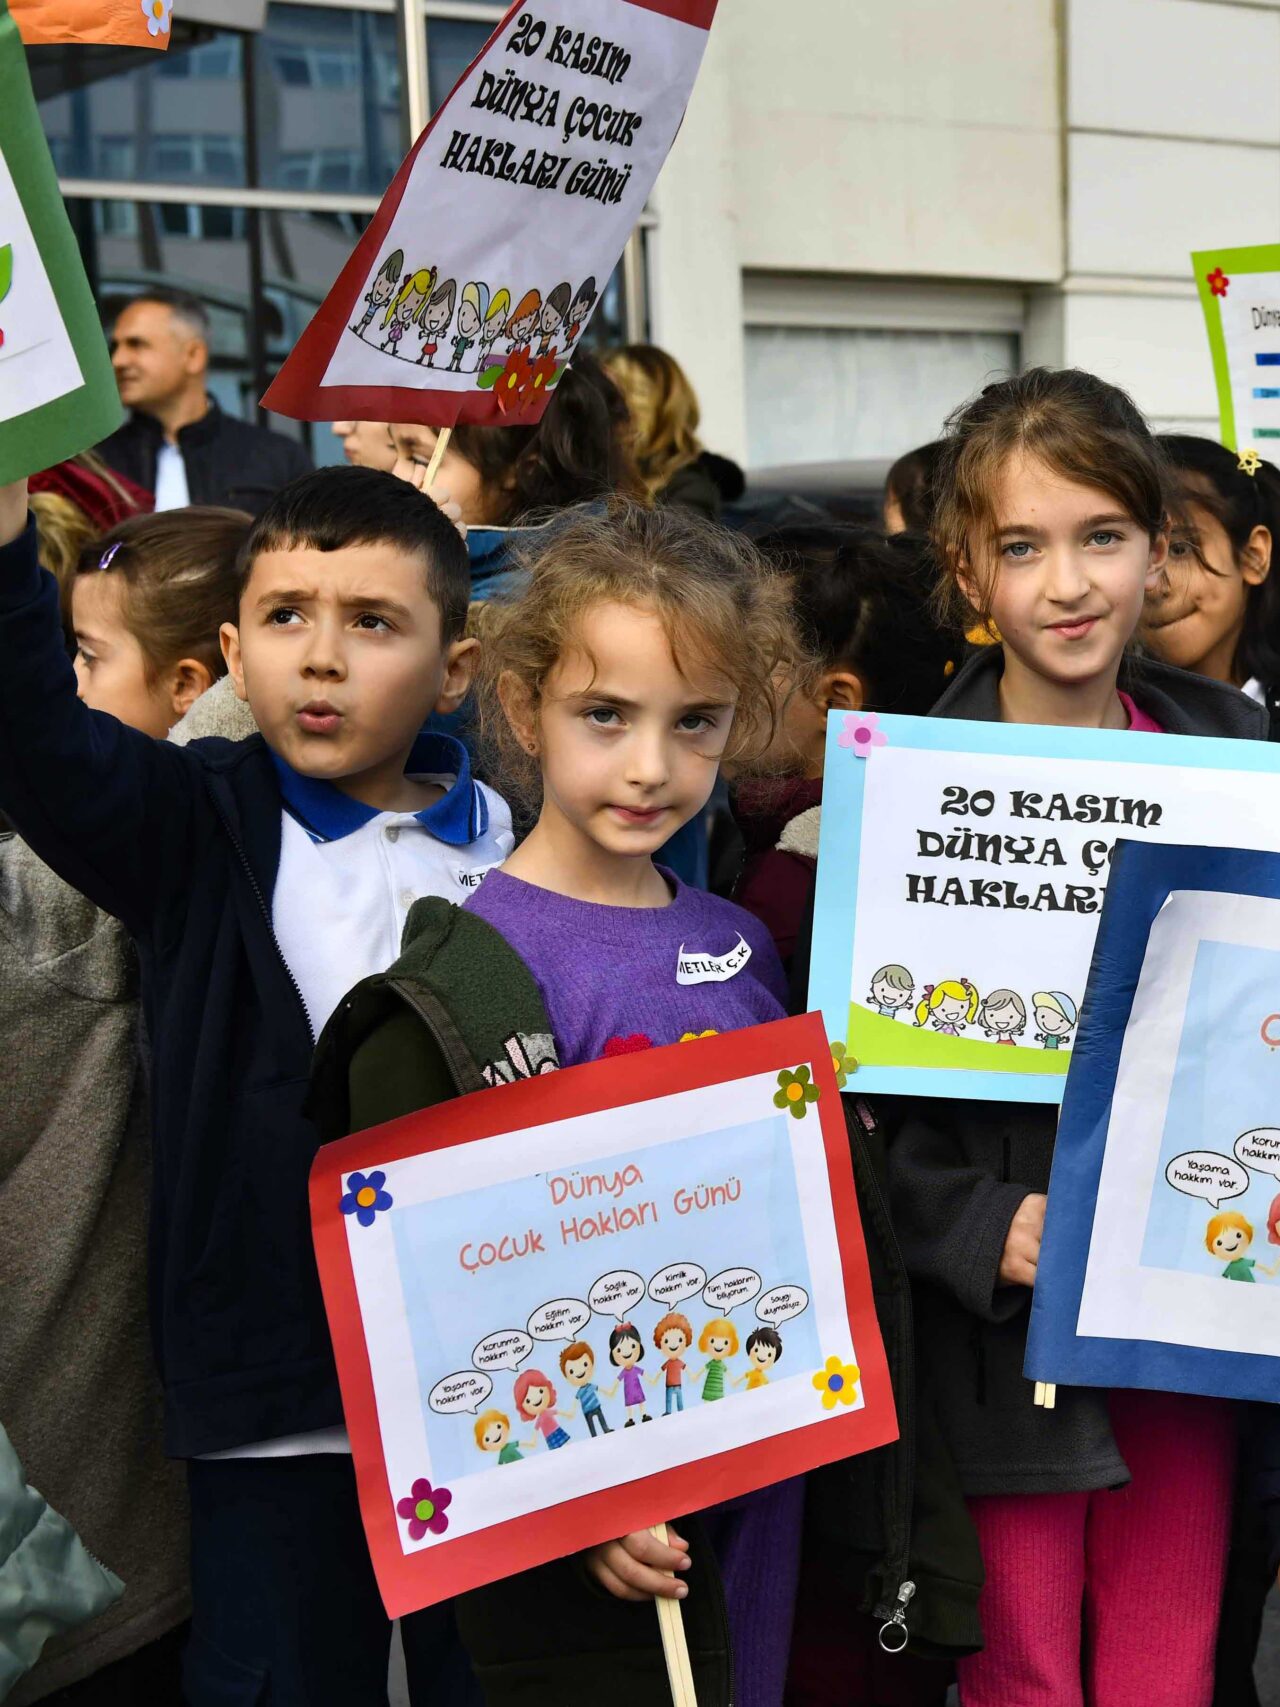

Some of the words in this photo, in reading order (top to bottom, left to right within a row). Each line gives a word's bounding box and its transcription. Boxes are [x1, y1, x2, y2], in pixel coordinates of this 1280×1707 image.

[505, 13, 546, 57] 20
[545, 25, 632, 85] KASIM
[470, 68, 560, 126] DÜNYA
[562, 96, 642, 146] ÇOCUK
[439, 130, 571, 189] HAKLARI
[565, 158, 633, 205] GÜNÜ
[941, 785, 994, 816] 20
[1009, 789, 1162, 827] KASIM
[917, 827, 1066, 866] DÜNYA
[1187, 1159, 1230, 1176] Yaşama
[1242, 1146, 1280, 1162] hakkım
[550, 1164, 644, 1206] Dünya
[1174, 1170, 1213, 1185] hakkım
[1218, 1178, 1239, 1190] var.
[459, 1229, 546, 1275] Çocuk
[560, 1201, 658, 1246] Hakları
[673, 1176, 742, 1216] Günü
